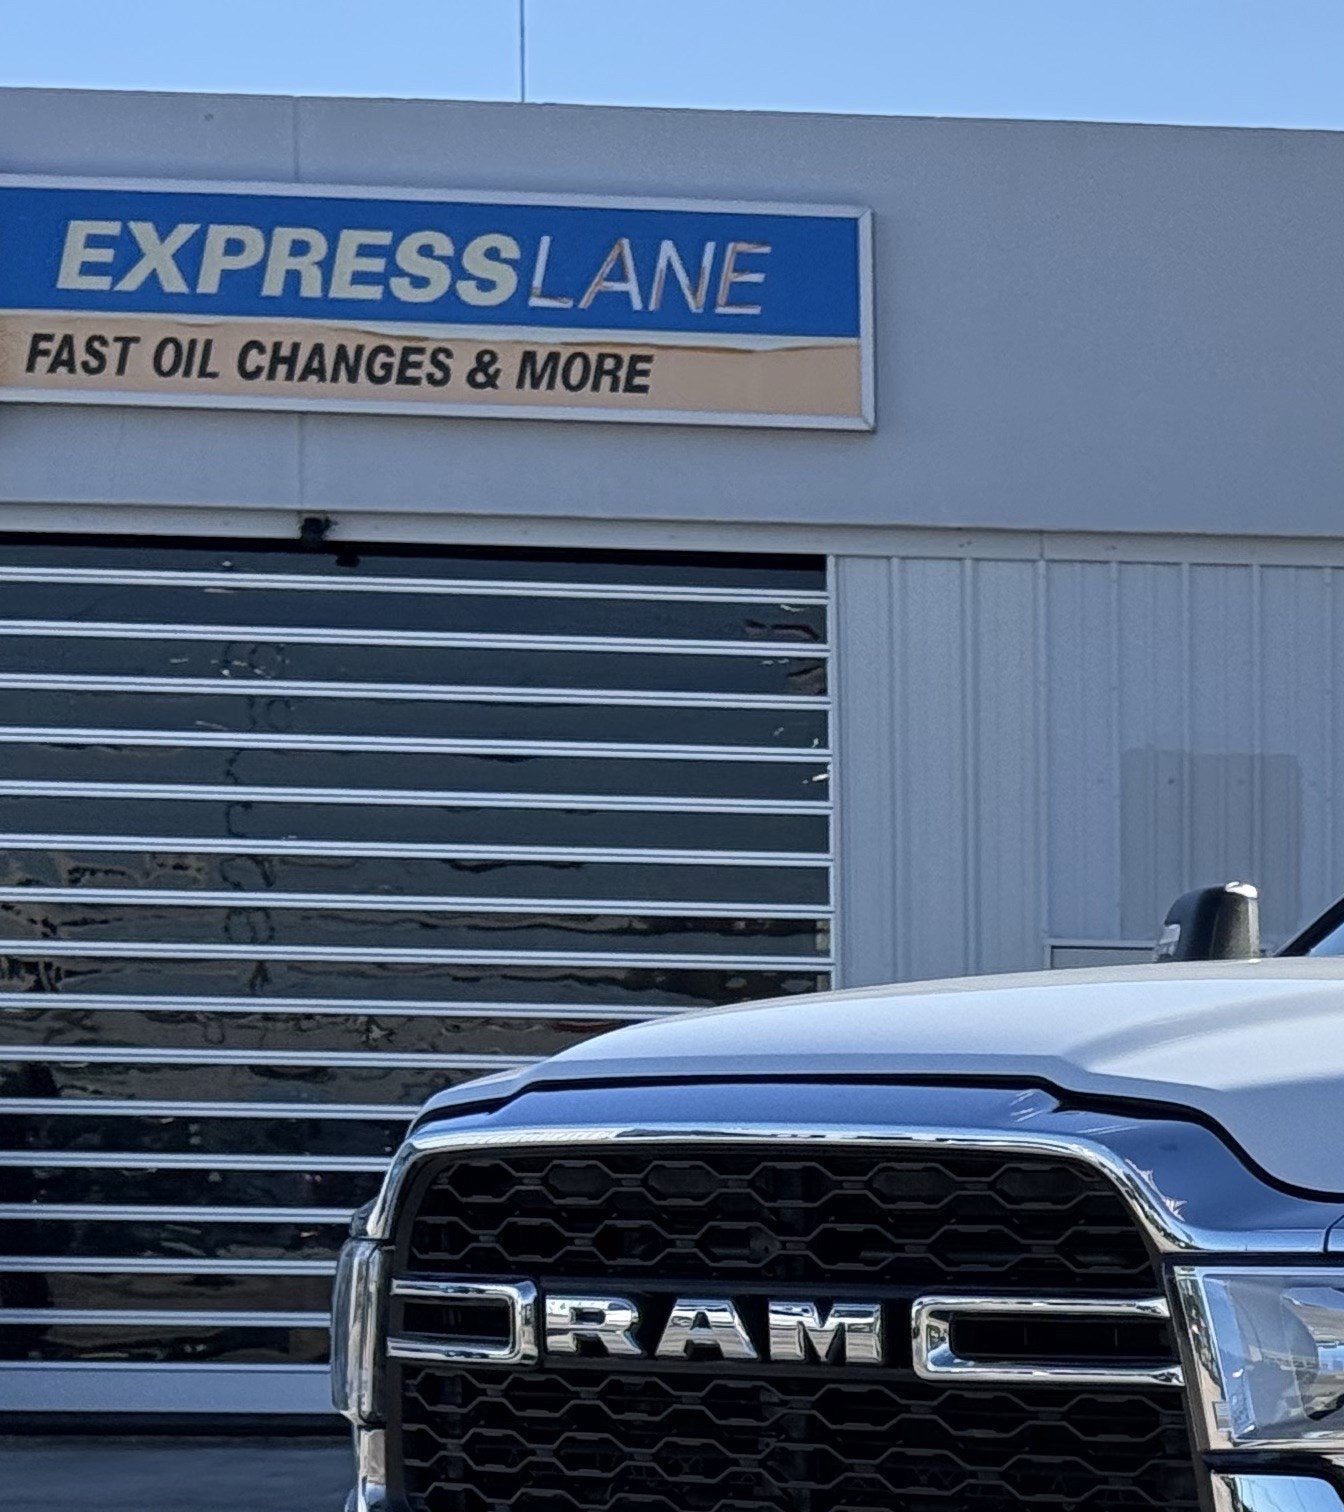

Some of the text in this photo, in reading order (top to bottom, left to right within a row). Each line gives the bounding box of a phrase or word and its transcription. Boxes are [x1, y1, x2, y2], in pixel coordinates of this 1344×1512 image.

[25, 333, 655, 395] FAST OIL CHANGES & MORE
[545, 1294, 884, 1366] RAM
